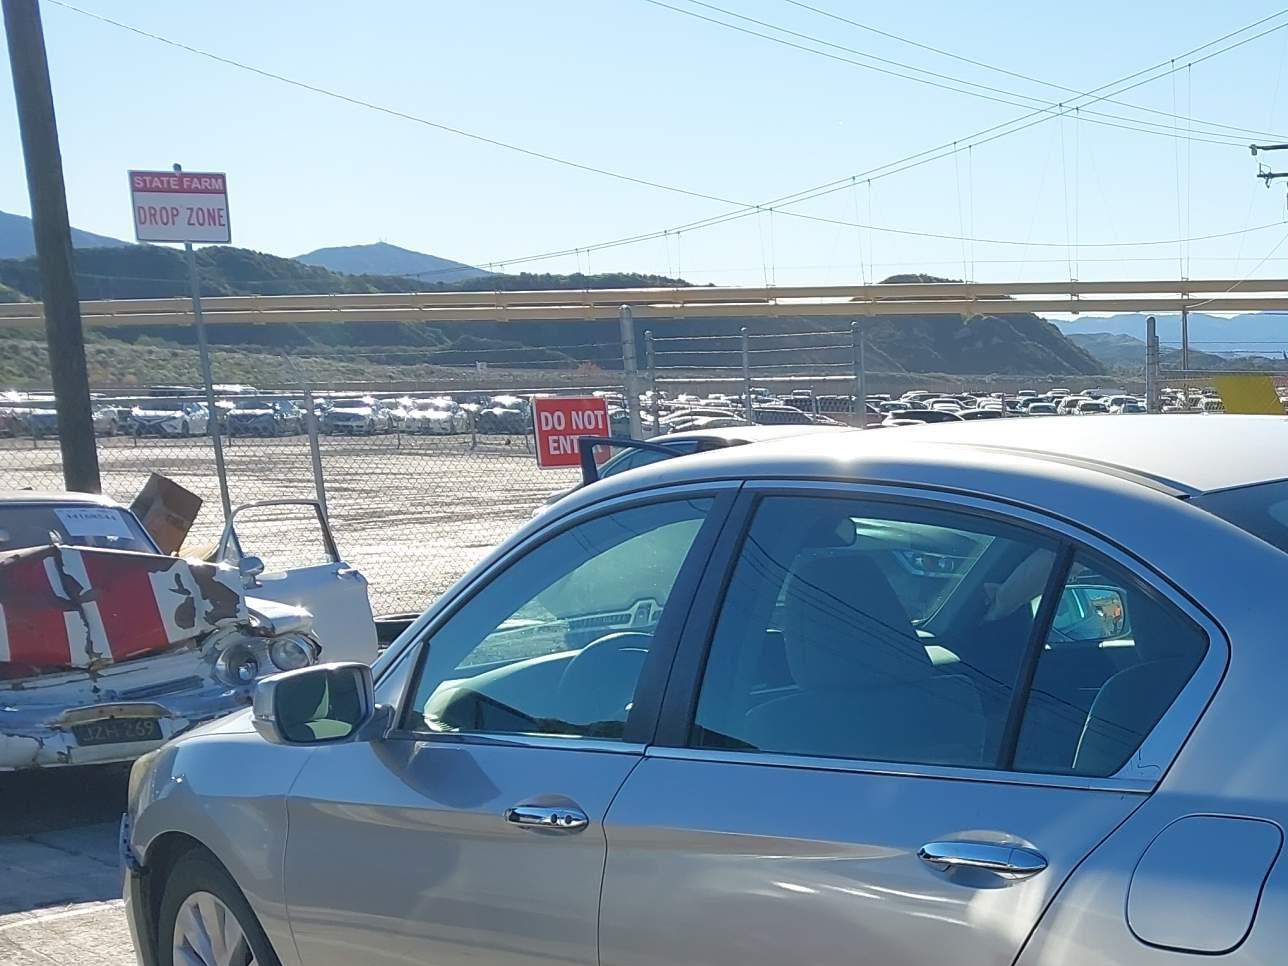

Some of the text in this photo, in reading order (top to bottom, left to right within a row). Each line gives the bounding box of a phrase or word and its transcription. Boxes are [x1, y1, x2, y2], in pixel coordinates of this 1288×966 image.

[134, 176, 224, 190] STATE FARM
[137, 206, 226, 227] DROP ZONE
[540, 410, 605, 431] DO NOT
[548, 435, 580, 455] ENT
